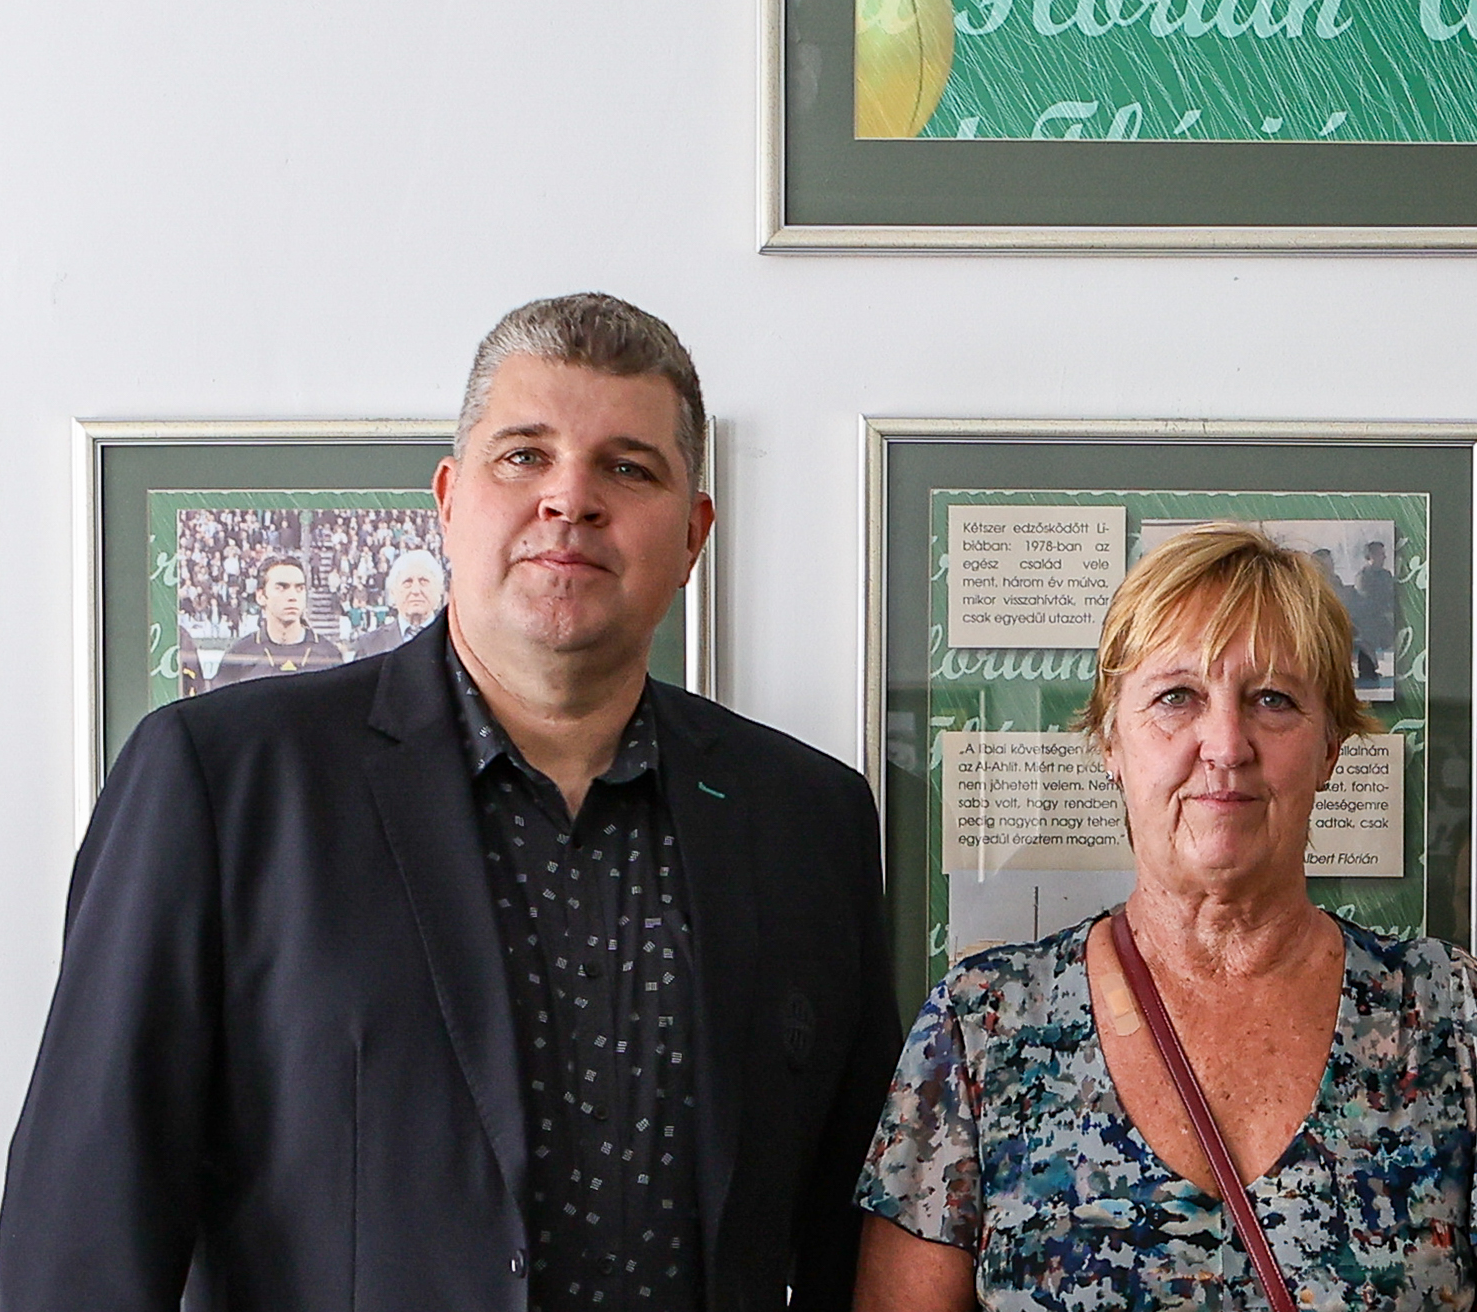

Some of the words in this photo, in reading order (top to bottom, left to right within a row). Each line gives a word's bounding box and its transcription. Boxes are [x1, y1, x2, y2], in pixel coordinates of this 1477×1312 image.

[963, 522, 1005, 533] Kétszer
[1013, 521, 1089, 533] edzősködött
[962, 539, 1011, 551] biában:
[1025, 540, 1082, 551] 1978-ban
[1095, 543, 1109, 551] az
[962, 557, 999, 571] egész
[1019, 558, 1061, 569] család
[1082, 558, 1109, 569] vele
[962, 576, 997, 587] ment,
[1002, 575, 1043, 587] három
[1047, 576, 1063, 587] év
[1067, 576, 1108, 588] múlva,
[962, 594, 996, 605] mikor
[1003, 594, 1075, 605] visszahívták,
[962, 612, 991, 623] csak
[993, 611, 1045, 625] egyedül
[1048, 612, 1095, 623] utazott.
[1335, 761, 1344, 774] a
[1346, 763, 1389, 774] család
[1351, 781, 1389, 793] fonto-
[1315, 817, 1355, 828] adtak,
[1359, 817, 1389, 828] csak
